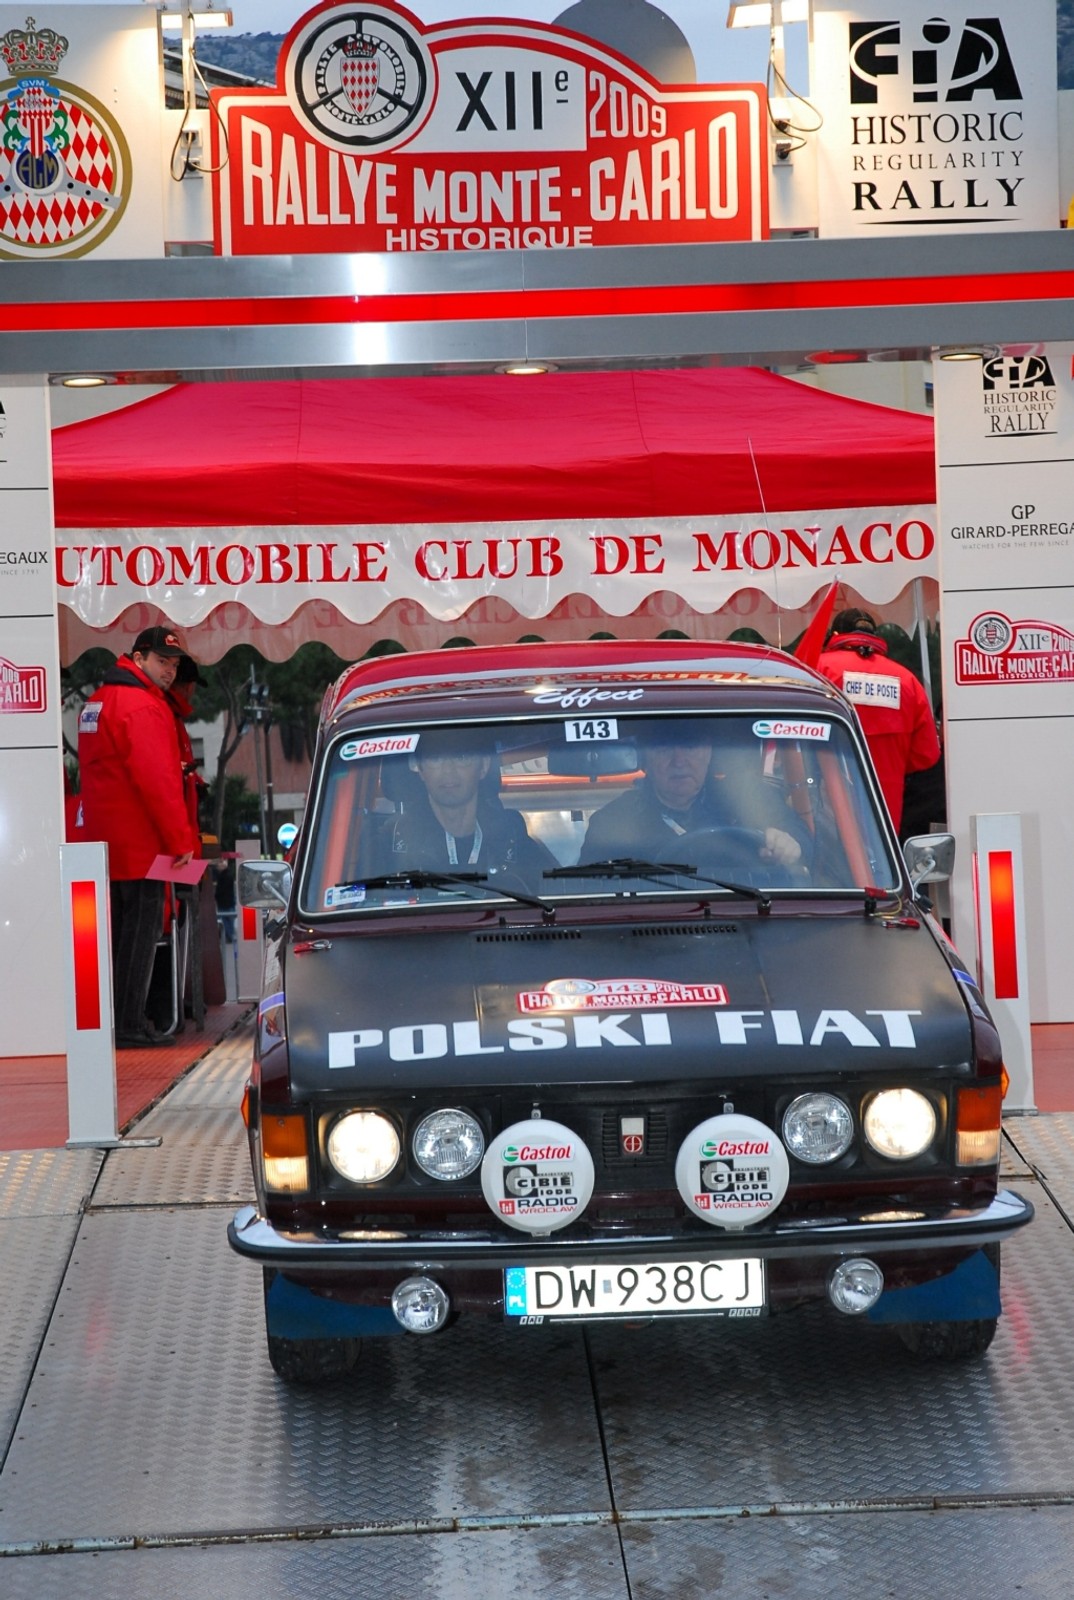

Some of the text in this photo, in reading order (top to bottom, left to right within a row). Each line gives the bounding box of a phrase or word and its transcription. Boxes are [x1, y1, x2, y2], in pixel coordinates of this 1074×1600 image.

[589, 70, 667, 138] 2009
[851, 111, 1024, 145] HISTORIC
[853, 150, 1024, 171] REGULARITY
[241, 115, 398, 226] RALLYE
[852, 177, 1025, 211] RALLY
[386, 226, 593, 251] HISTORIQUE
[984, 389, 1057, 405] HISTORIC
[984, 402, 1056, 414] REGULARITY
[991, 412, 1049, 433] RALLY
[1011, 504, 1036, 520] GP
[415, 537, 564, 581] CLUB
[589, 534, 665, 576] DE
[692, 520, 935, 572] MONACO
[962, 648, 1004, 675] RALLYE
[533, 688, 645, 709] Effect
[846, 681, 898, 699] CHEF DE POSTE
[573, 720, 611, 739] 143
[772, 722, 825, 737] Castrol
[359, 738, 412, 755] Castrol
[593, 986, 718, 1005] MONTE-CARLO
[604, 984, 649, 993] 143
[328, 1010, 923, 1069] POLSKI FIAT
[520, 1145, 571, 1160] Castrol
[718, 1141, 769, 1156] Castrol
[518, 1197, 578, 1208] RADIO
[713, 1192, 773, 1203] RADIO
[535, 1269, 597, 1309] DW
